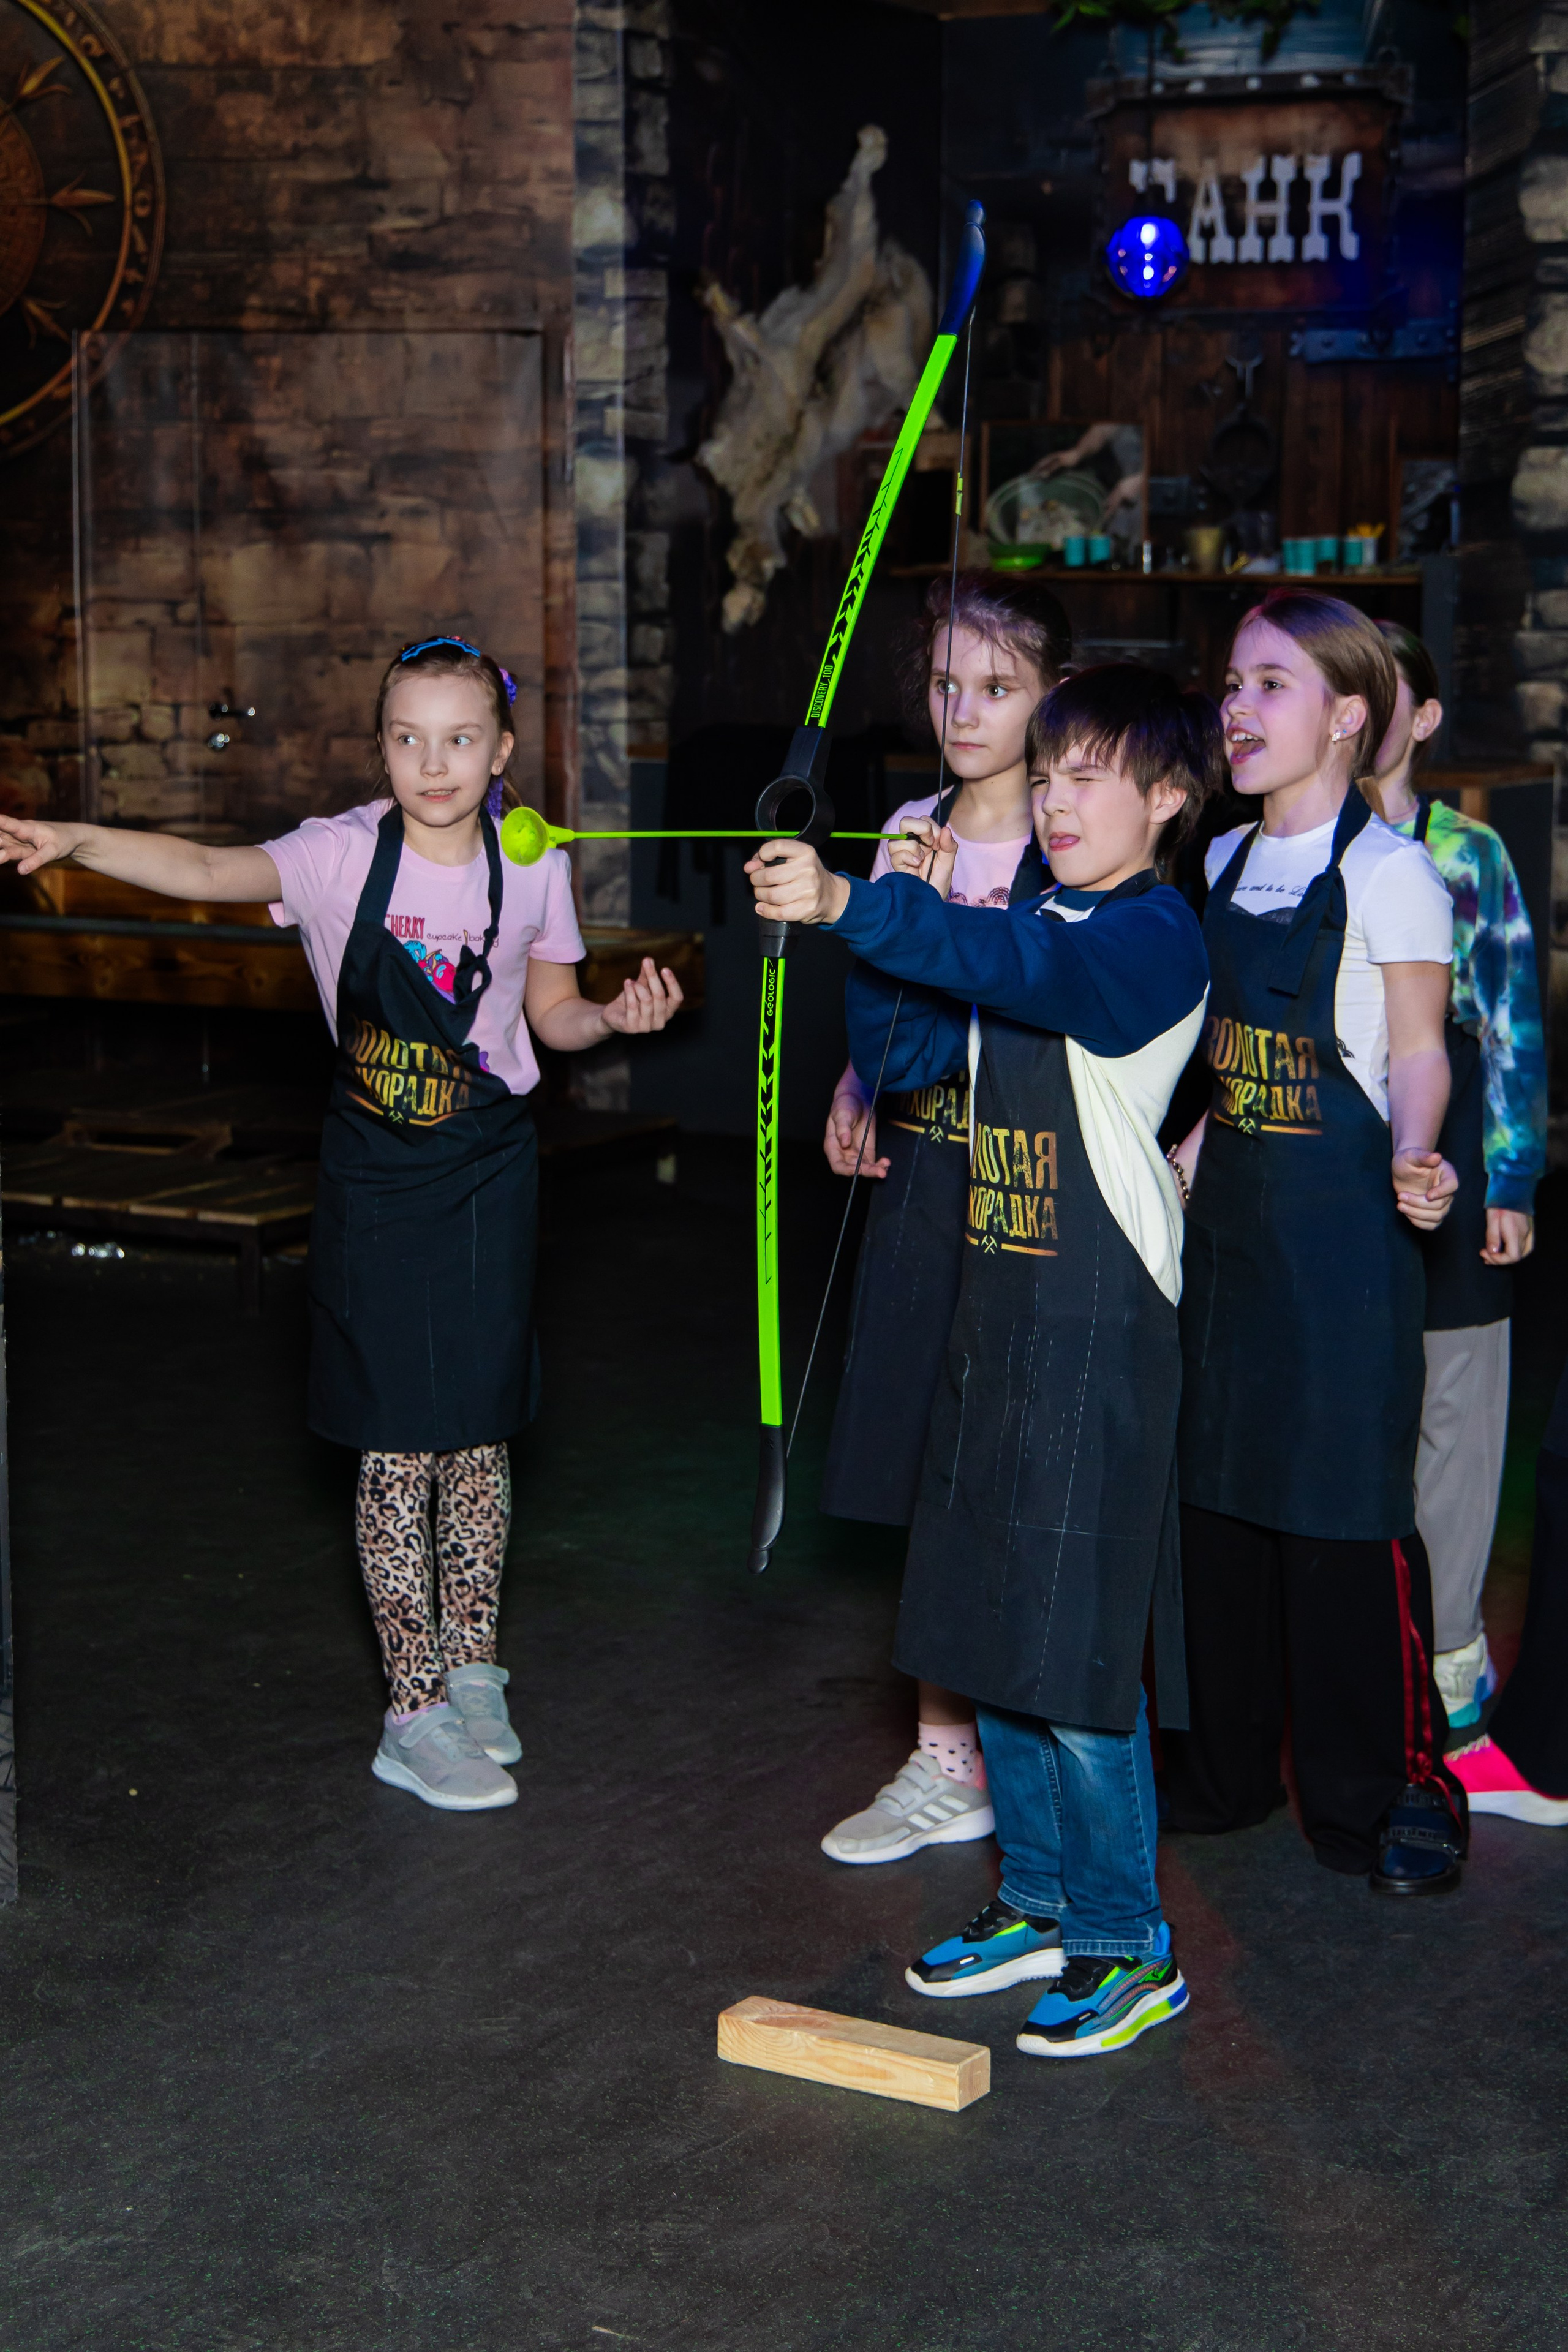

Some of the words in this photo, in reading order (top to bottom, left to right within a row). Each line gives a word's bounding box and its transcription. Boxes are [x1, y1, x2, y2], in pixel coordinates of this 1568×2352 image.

[810, 682, 828, 718] DISCOVERY
[822, 665, 833, 678] 100
[386, 914, 425, 940] HERRY
[427, 933, 462, 942] cupcake
[469, 933, 499, 948] baky
